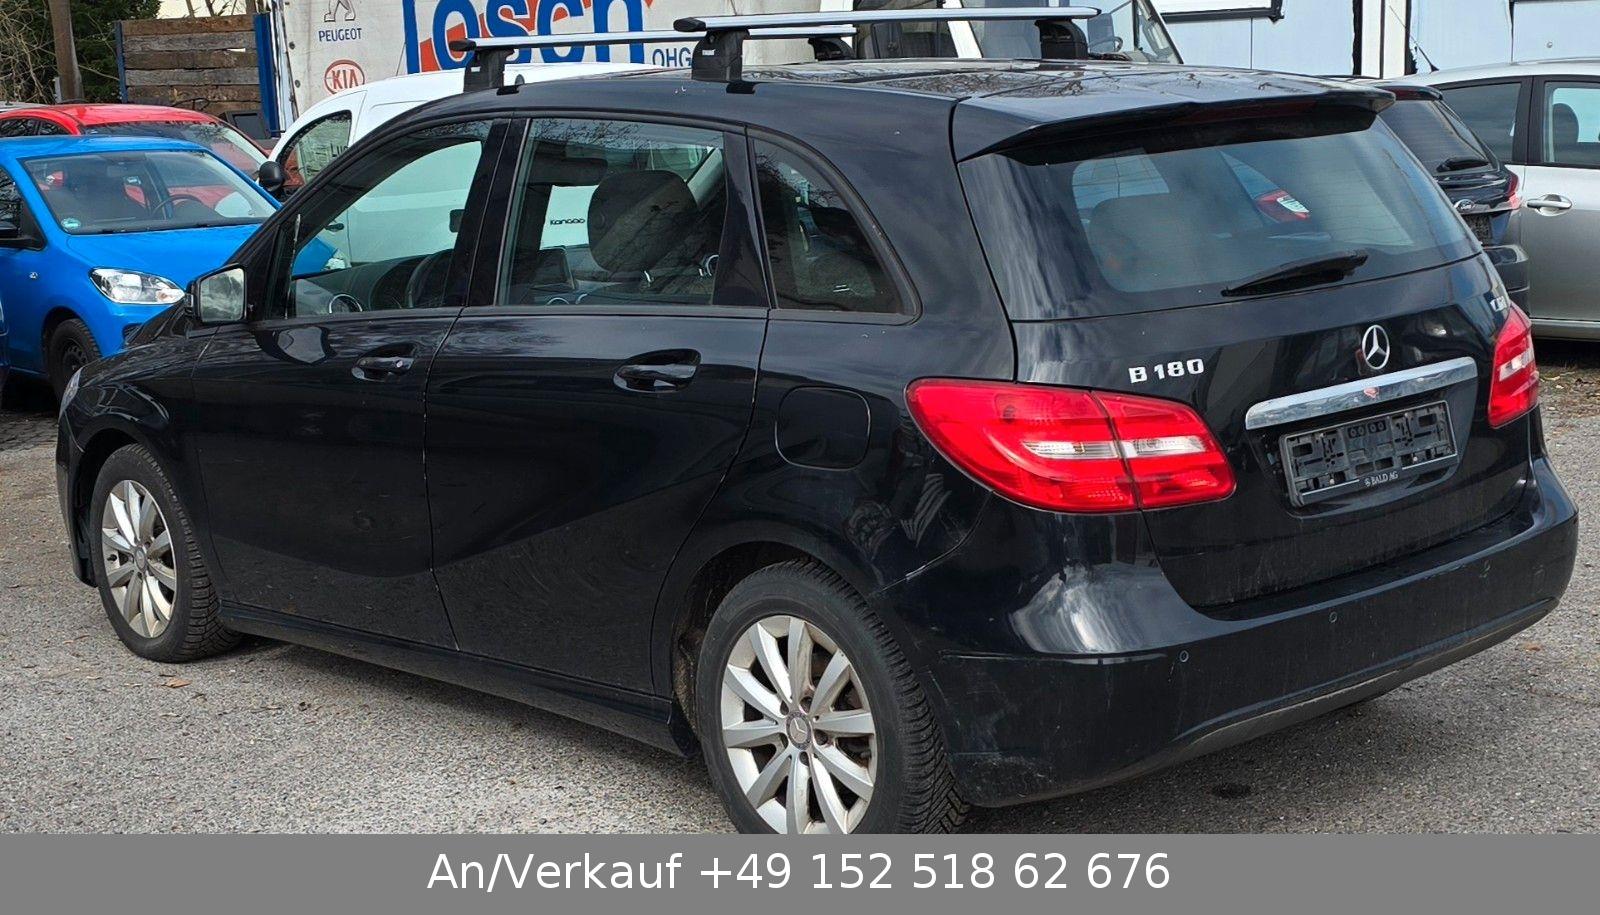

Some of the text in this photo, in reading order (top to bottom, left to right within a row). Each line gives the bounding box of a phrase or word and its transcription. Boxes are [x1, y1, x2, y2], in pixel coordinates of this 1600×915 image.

[318, 28, 362, 42] PEUGEOT
[652, 46, 693, 67] OHG
[332, 69, 359, 89] KIA
[1128, 358, 1205, 384] B 180
